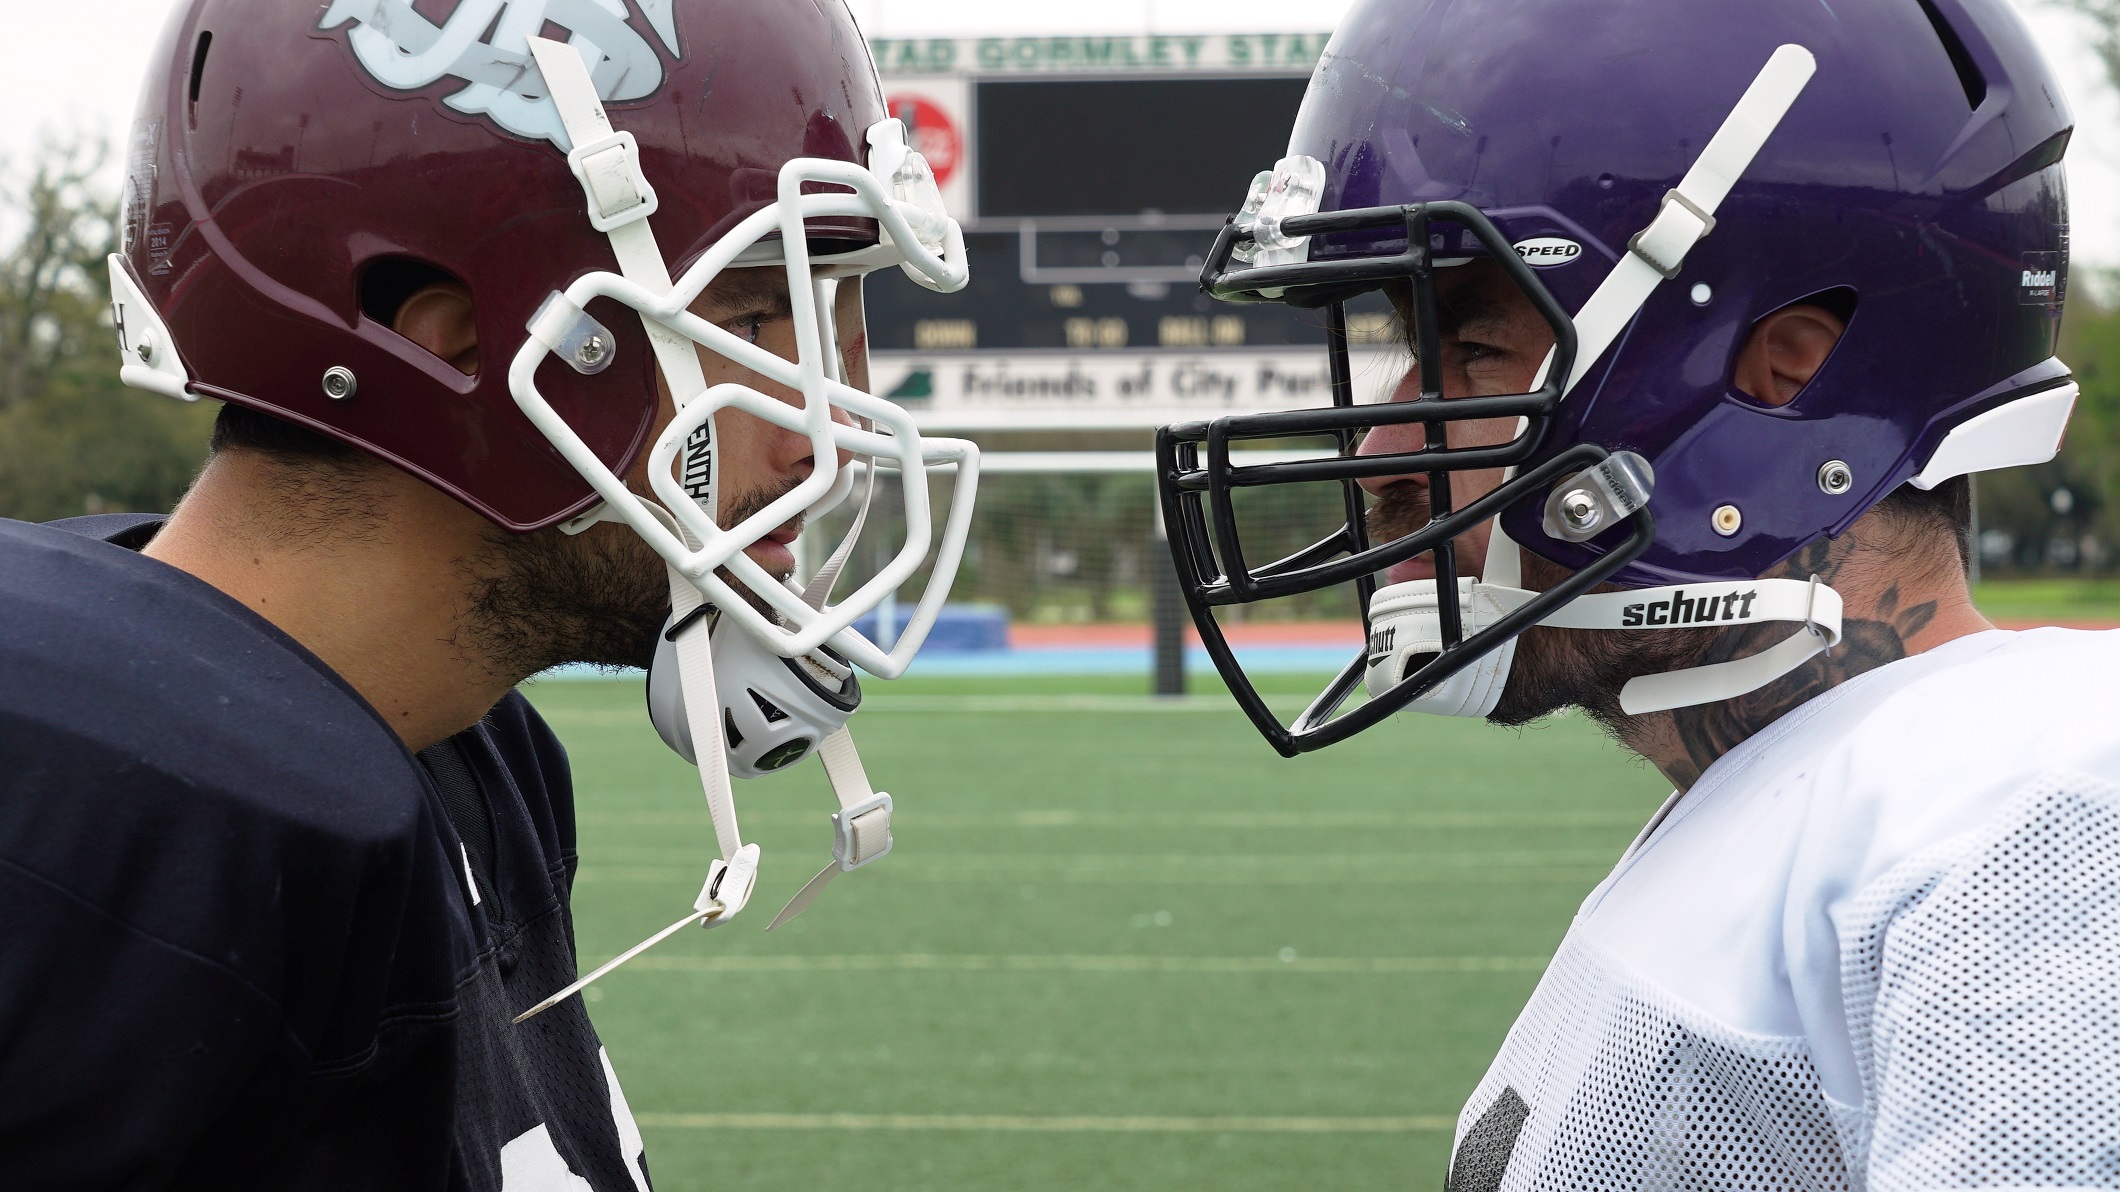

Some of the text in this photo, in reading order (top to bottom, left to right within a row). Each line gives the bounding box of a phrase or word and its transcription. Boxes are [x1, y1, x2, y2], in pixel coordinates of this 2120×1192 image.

[977, 37, 1204, 66] GORMLEY
[1514, 244, 1580, 258] SPEED
[2021, 269, 2057, 287] Riddell
[963, 361, 1097, 398] Friends
[1117, 360, 1155, 396] of
[1171, 360, 1237, 406] City
[684, 418, 711, 500] ENITH
[1599, 463, 1638, 511] Riddell
[1622, 589, 1757, 626] schutt
